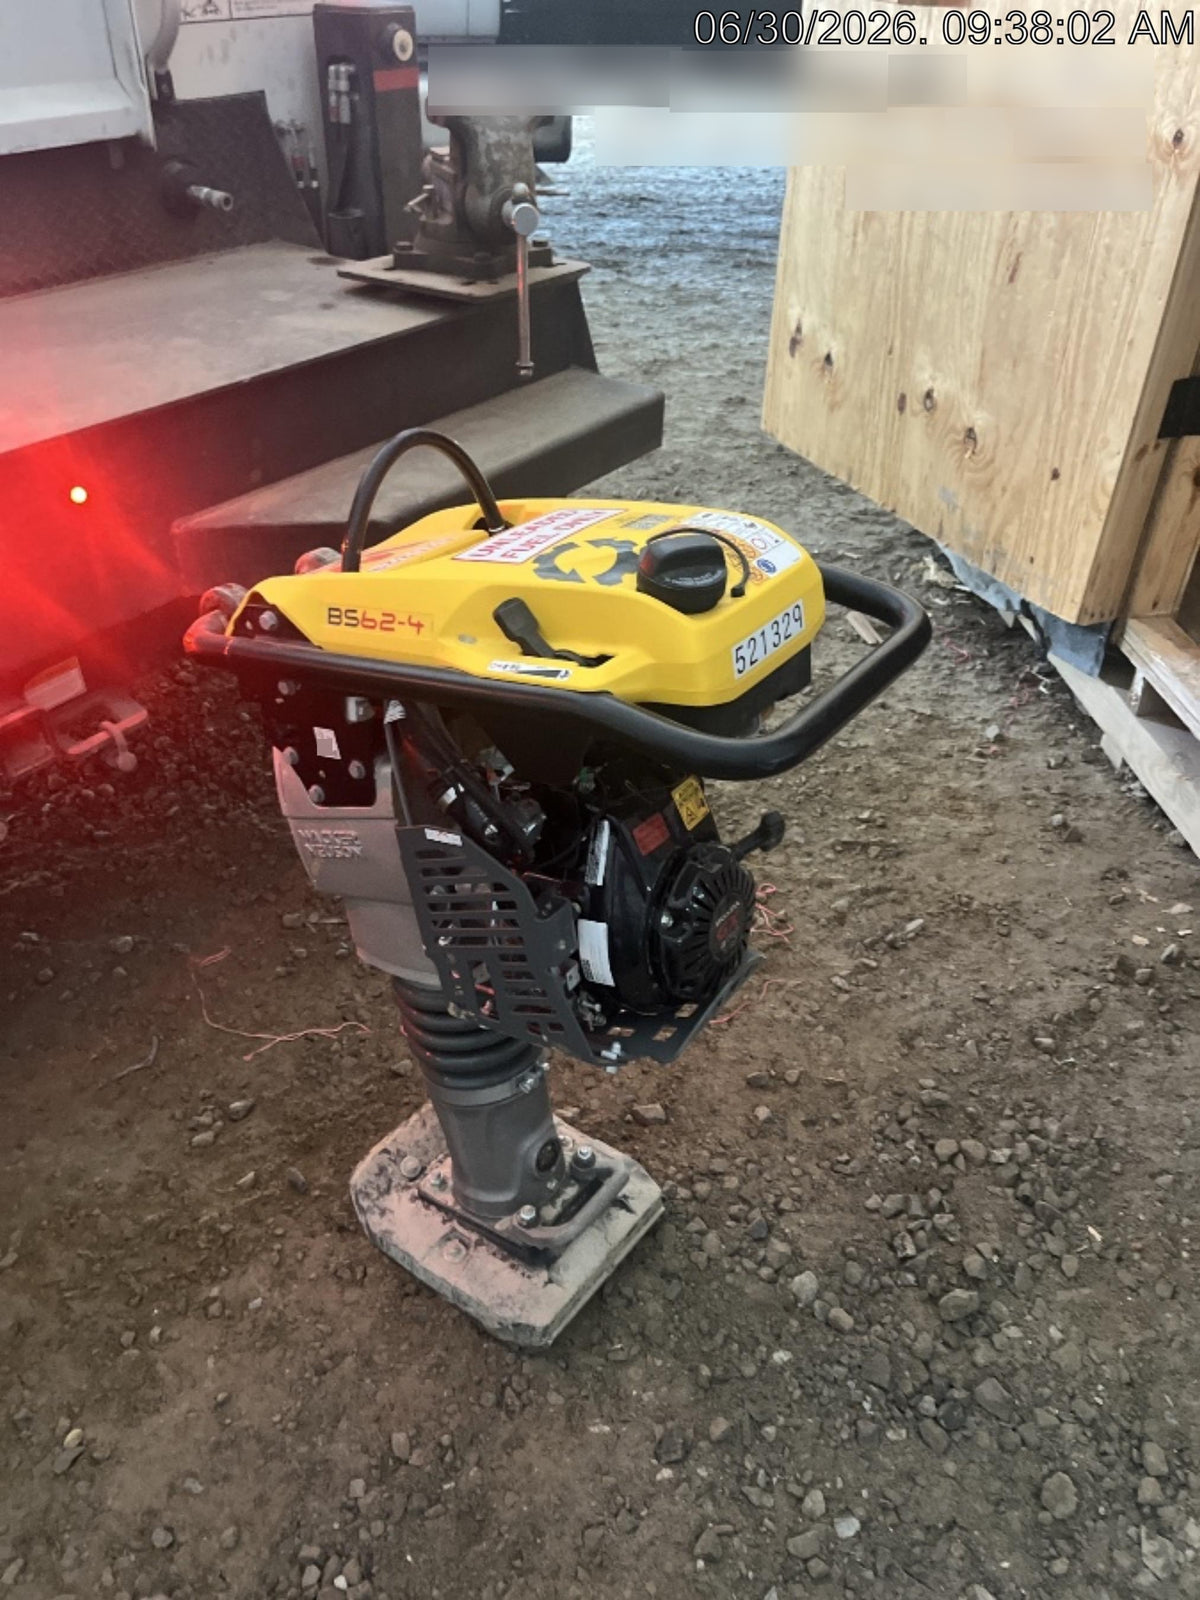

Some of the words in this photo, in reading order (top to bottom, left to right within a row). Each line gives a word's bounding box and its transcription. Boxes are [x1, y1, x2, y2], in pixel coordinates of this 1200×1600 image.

[500, 532, 560, 559] FUEL
[327, 606, 425, 636] BS62-4
[735, 603, 803, 675] 521329
